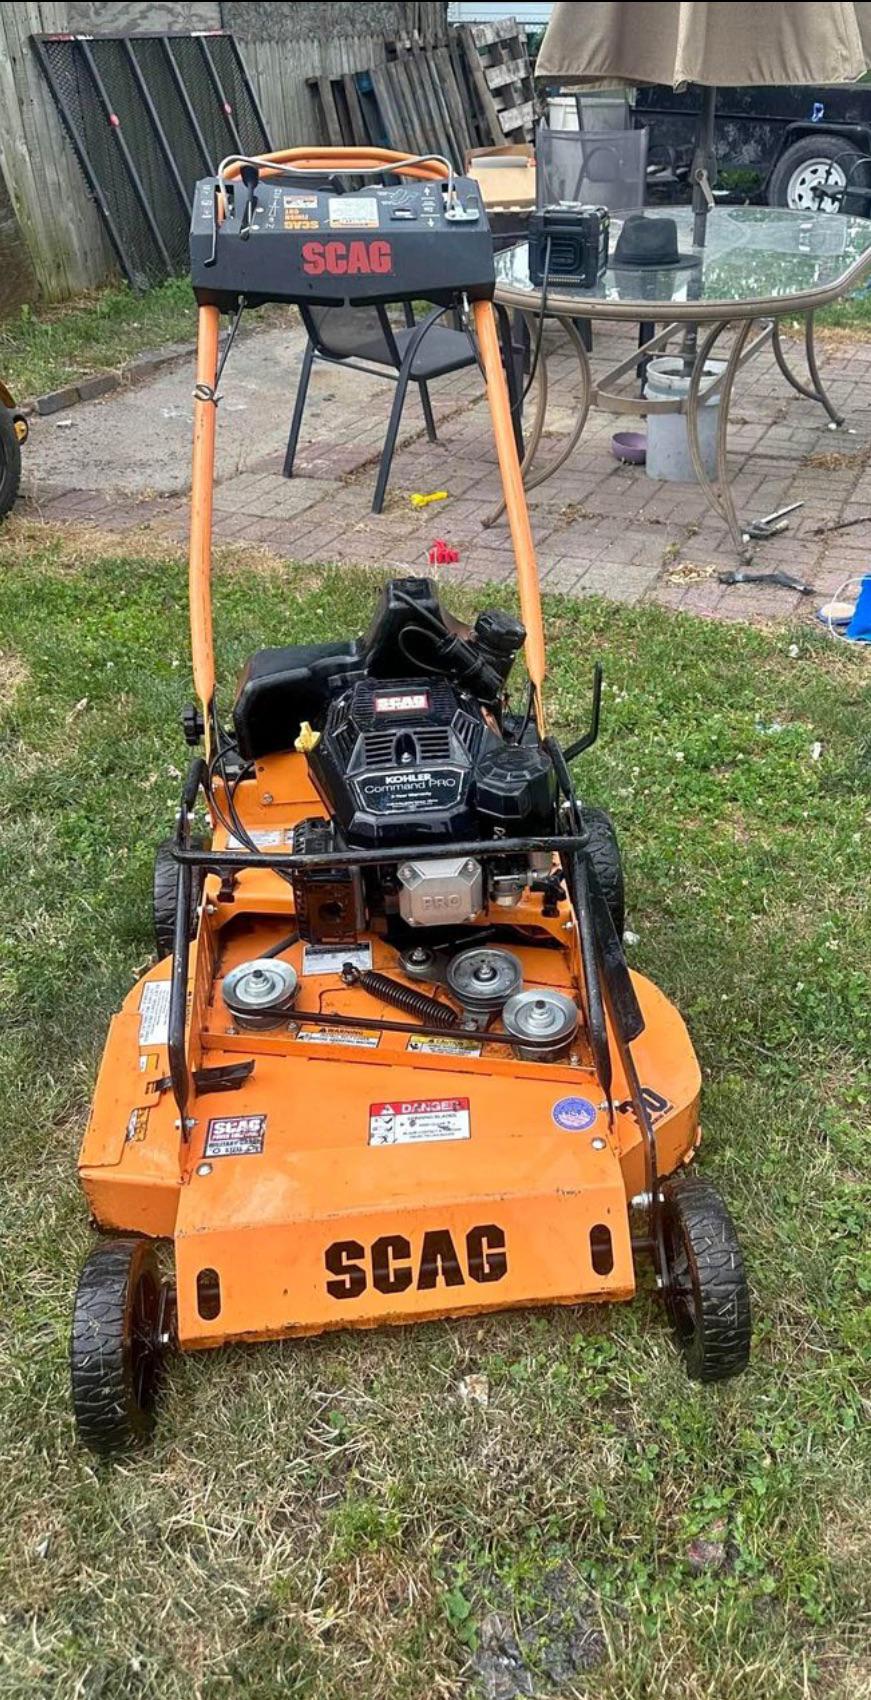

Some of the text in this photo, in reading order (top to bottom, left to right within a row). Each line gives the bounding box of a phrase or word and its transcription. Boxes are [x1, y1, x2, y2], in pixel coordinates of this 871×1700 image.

[283, 220, 320, 230] SCAG
[302, 240, 392, 275] SCAG
[364, 778, 456, 794] Command PRO
[385, 773, 432, 784] KOHLER
[422, 894, 462, 911] PRO
[402, 1100, 461, 1114] DANGER
[213, 1118, 261, 1134] SCAG
[324, 1223, 508, 1300] SCAG
